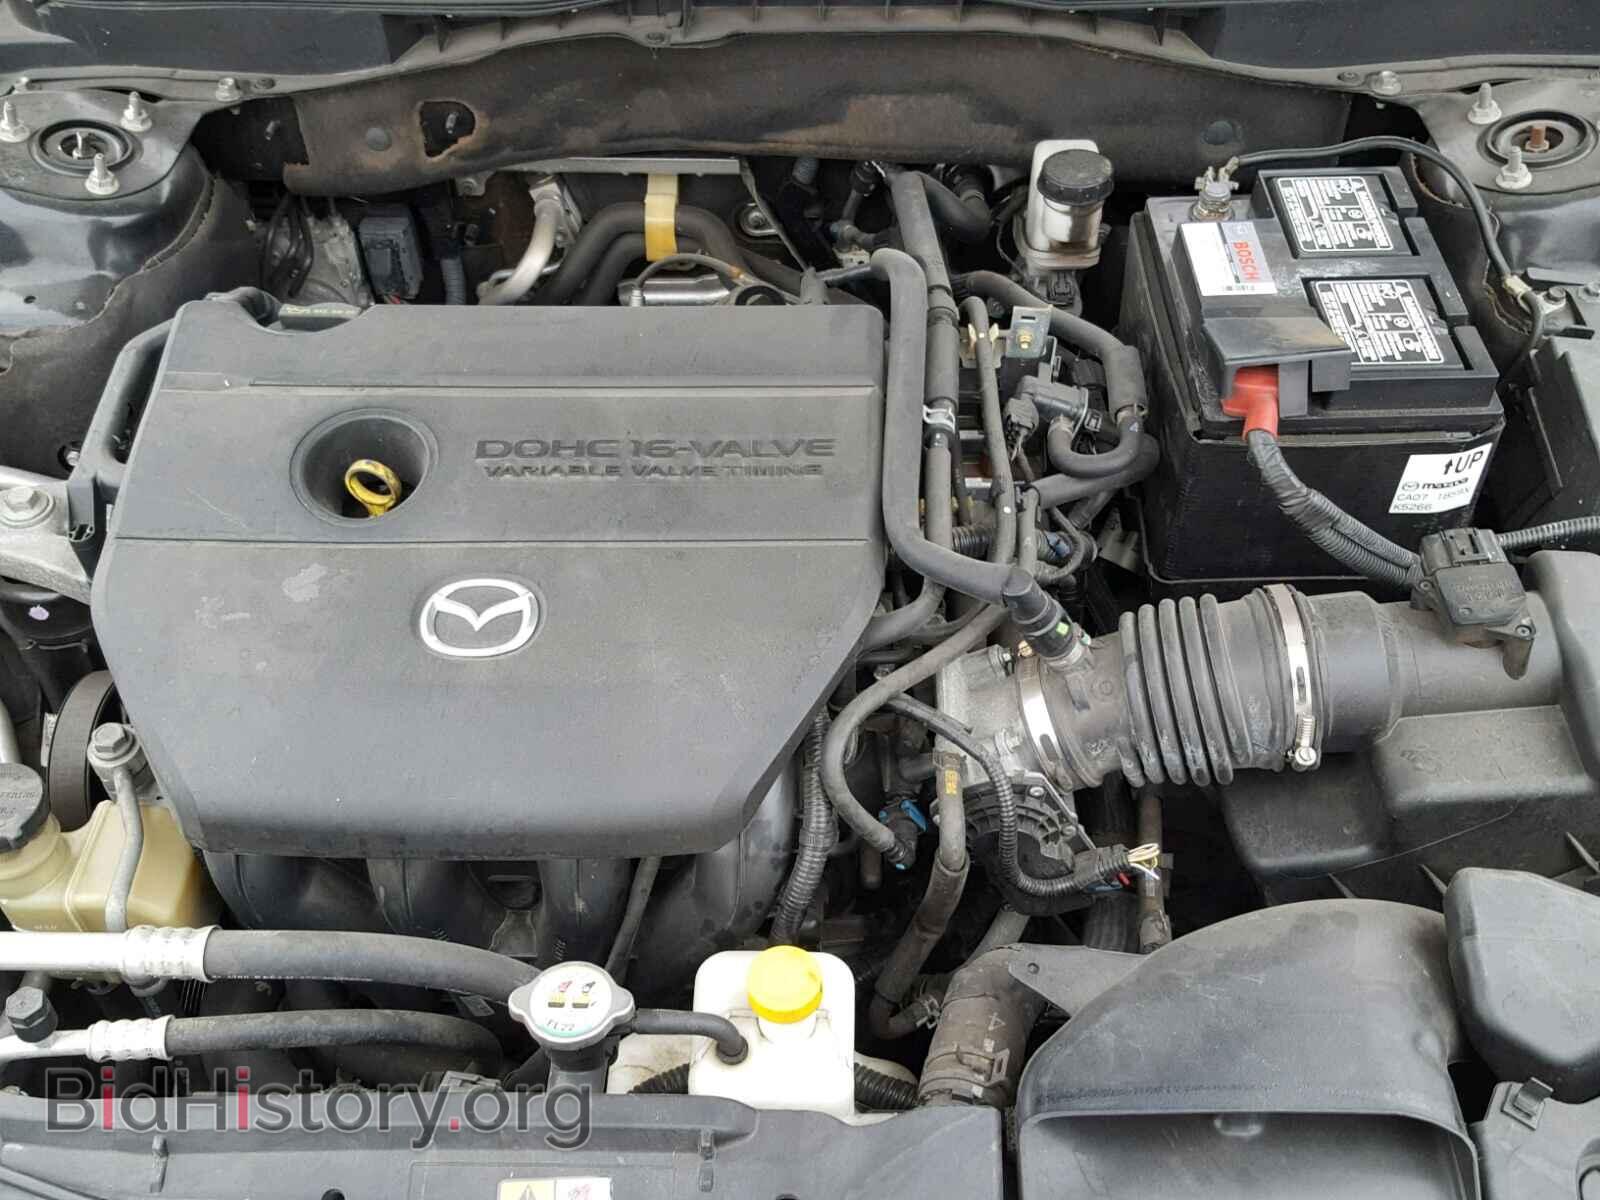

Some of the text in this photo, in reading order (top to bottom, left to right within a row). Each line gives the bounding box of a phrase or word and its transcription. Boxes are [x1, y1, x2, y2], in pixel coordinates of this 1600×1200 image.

[1233, 241, 1260, 282] BOSCH
[475, 438, 837, 458] DOHC 16-VALVE
[484, 463, 824, 478] VARIABLE VALVE TIMING
[1455, 450, 1484, 473] UP
